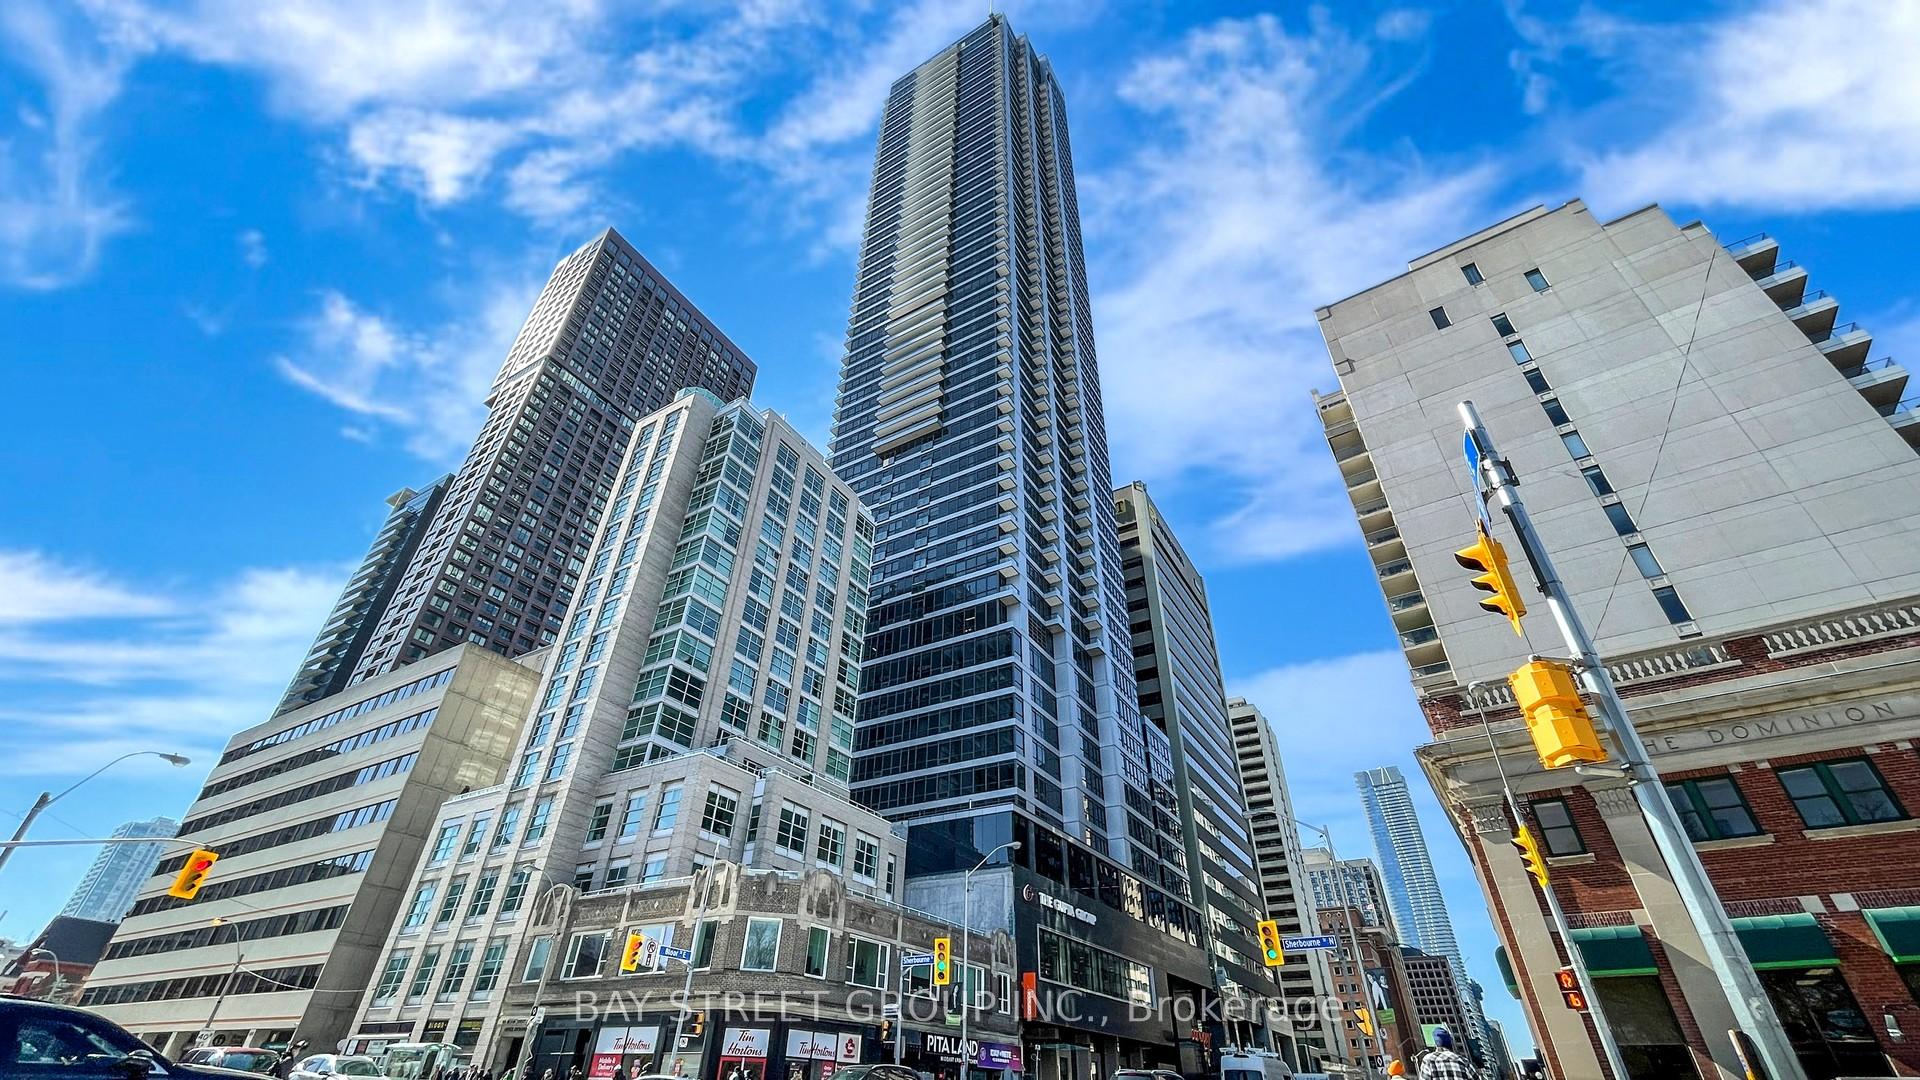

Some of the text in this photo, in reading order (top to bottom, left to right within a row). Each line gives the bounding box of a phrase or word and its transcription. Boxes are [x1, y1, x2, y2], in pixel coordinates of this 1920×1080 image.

[1642, 702, 1896, 751] HE DOMINION
[1285, 940, 1321, 949] Sherbourne
[1329, 937, 1335, 946] N
[665, 947, 679, 957] Bloor
[903, 957, 930, 965] Sherbourne
[739, 1030, 754, 1042] Tim
[613, 1037, 650, 1050] Tim Hortons
[727, 1042, 762, 1055] Hortons
[799, 1042, 812, 1055] Tim
[812, 1043, 835, 1057] Hortons
[927, 1034, 950, 1054] PITA
[951, 1038, 978, 1056] LAND
